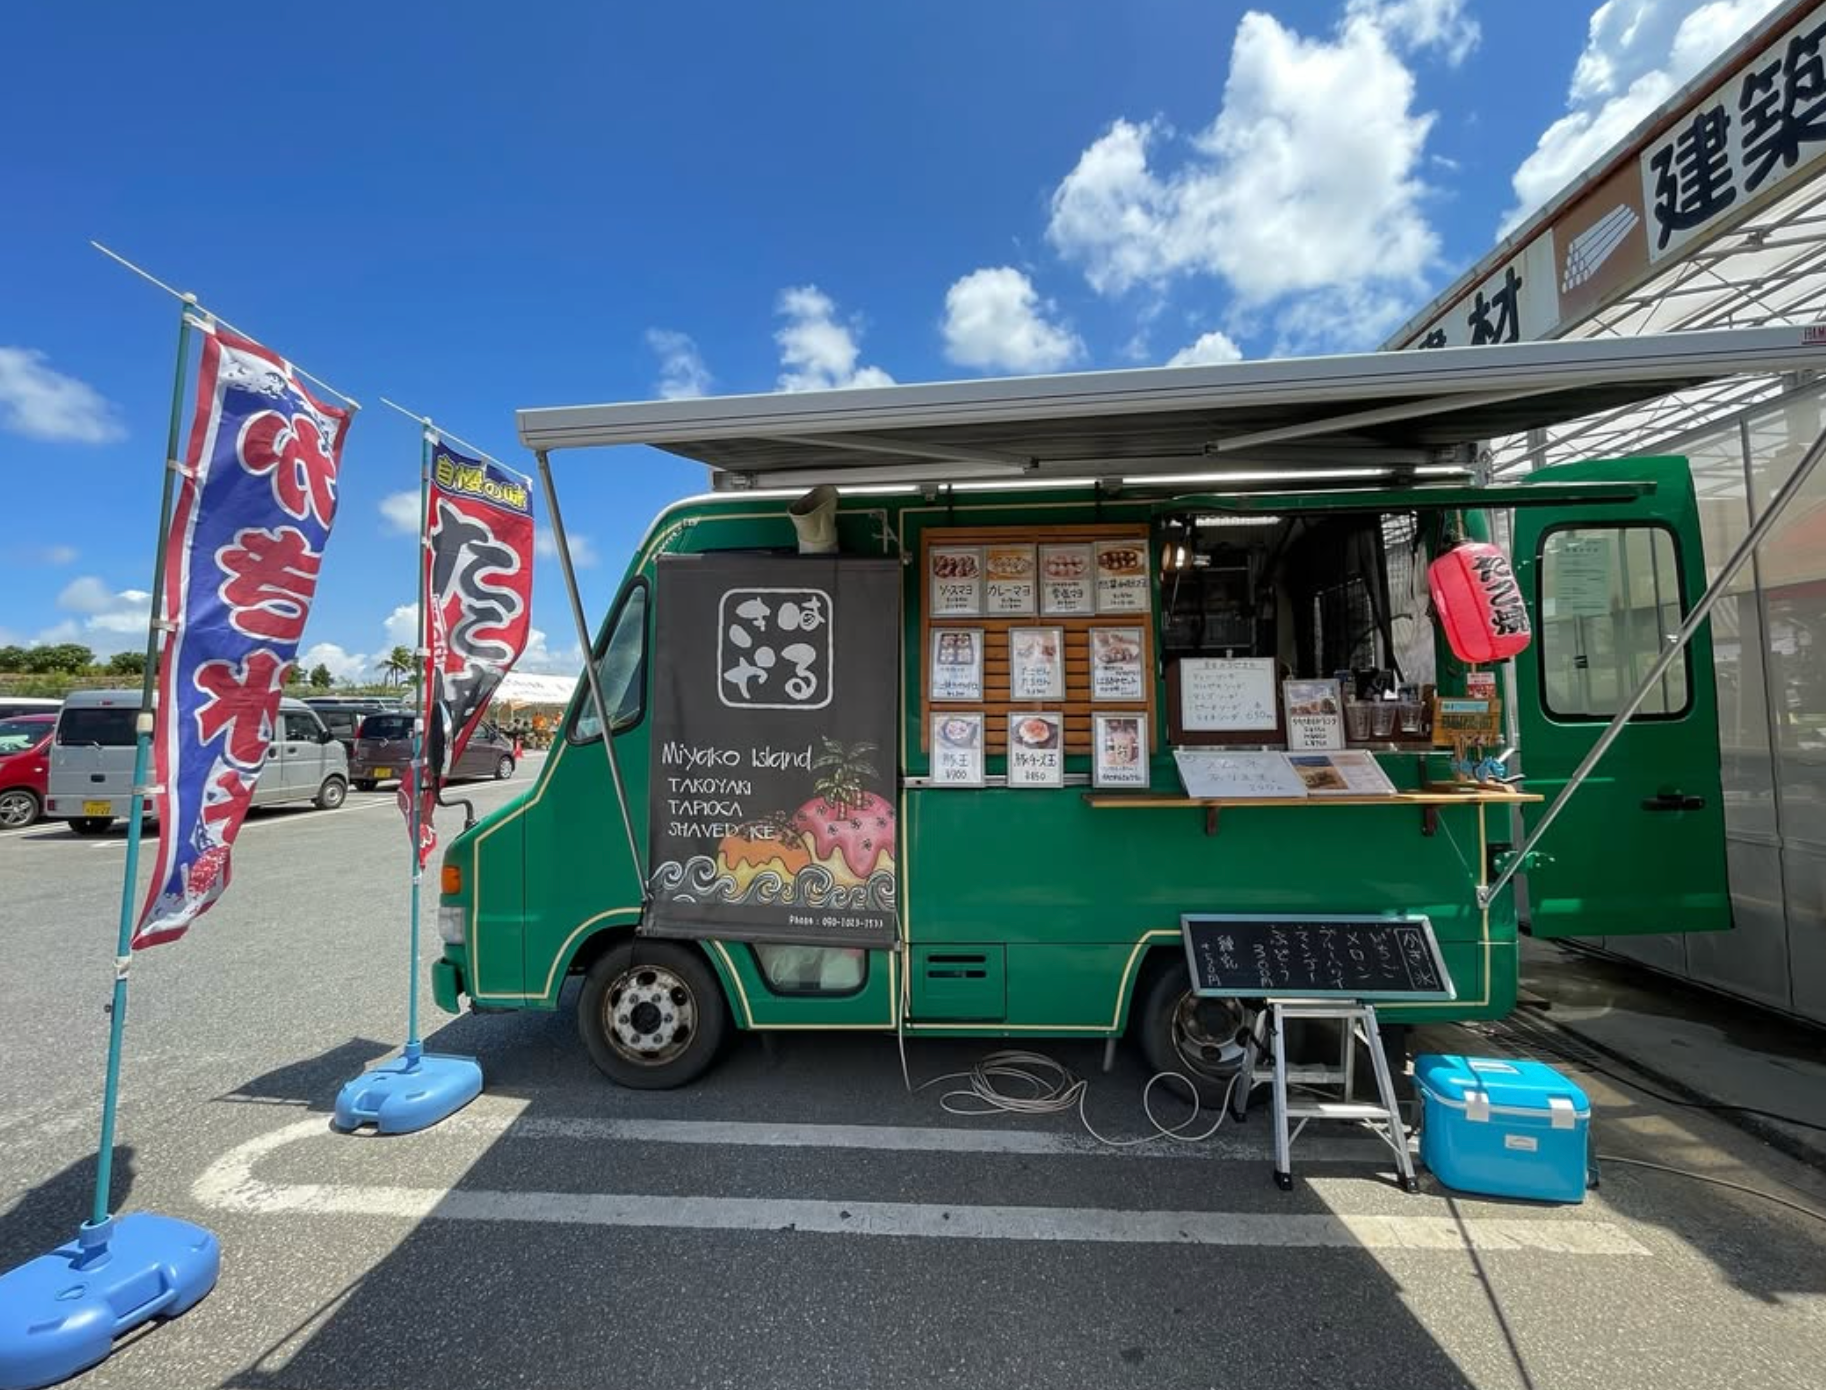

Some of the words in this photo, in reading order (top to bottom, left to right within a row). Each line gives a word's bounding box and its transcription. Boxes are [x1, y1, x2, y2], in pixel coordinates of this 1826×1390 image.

[435, 454, 526, 514] 自慢の味
[662, 741, 740, 771] Miyako
[752, 745, 812, 771] Island
[668, 778, 751, 795] TAKOYAKI
[668, 800, 742, 817] TAPIOCA
[668, 822, 739, 838] SHAVED
[750, 825, 775, 840] ICE
